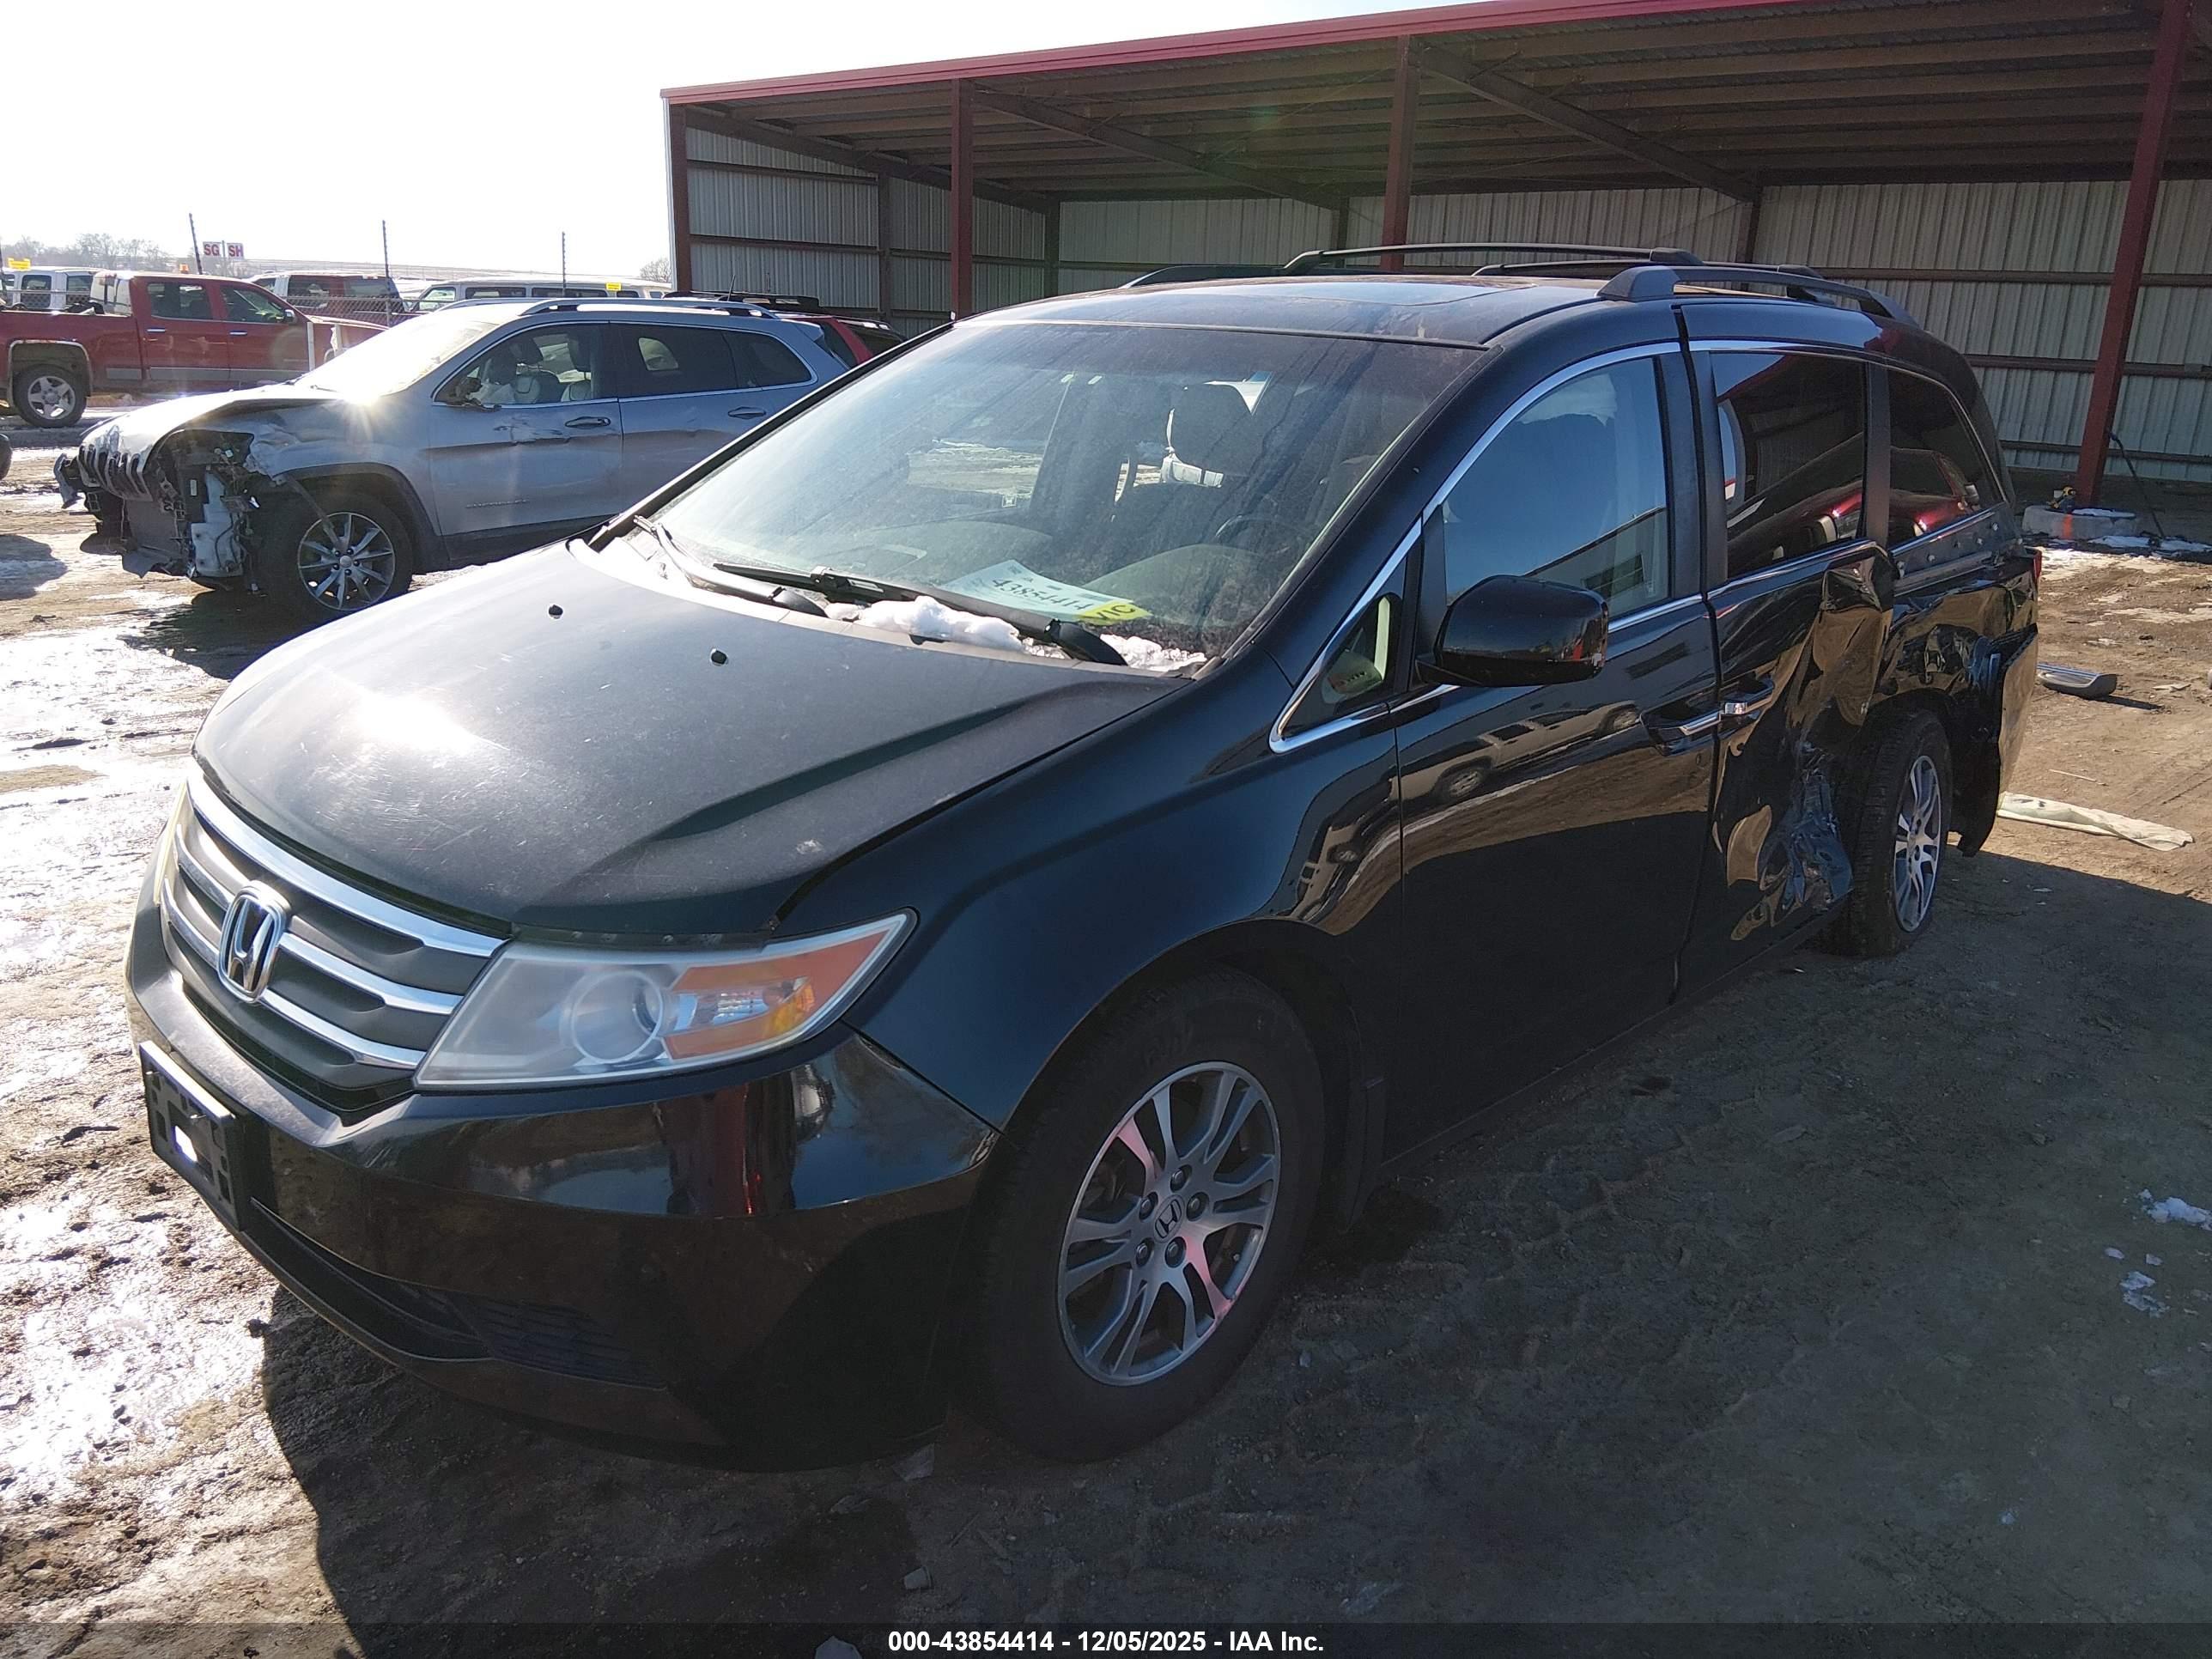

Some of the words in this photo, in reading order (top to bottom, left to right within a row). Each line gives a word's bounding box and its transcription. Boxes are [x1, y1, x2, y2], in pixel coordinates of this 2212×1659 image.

[204, 244, 220, 256] SG
[228, 246, 244, 257] SH
[993, 578, 1094, 611] 43854414
